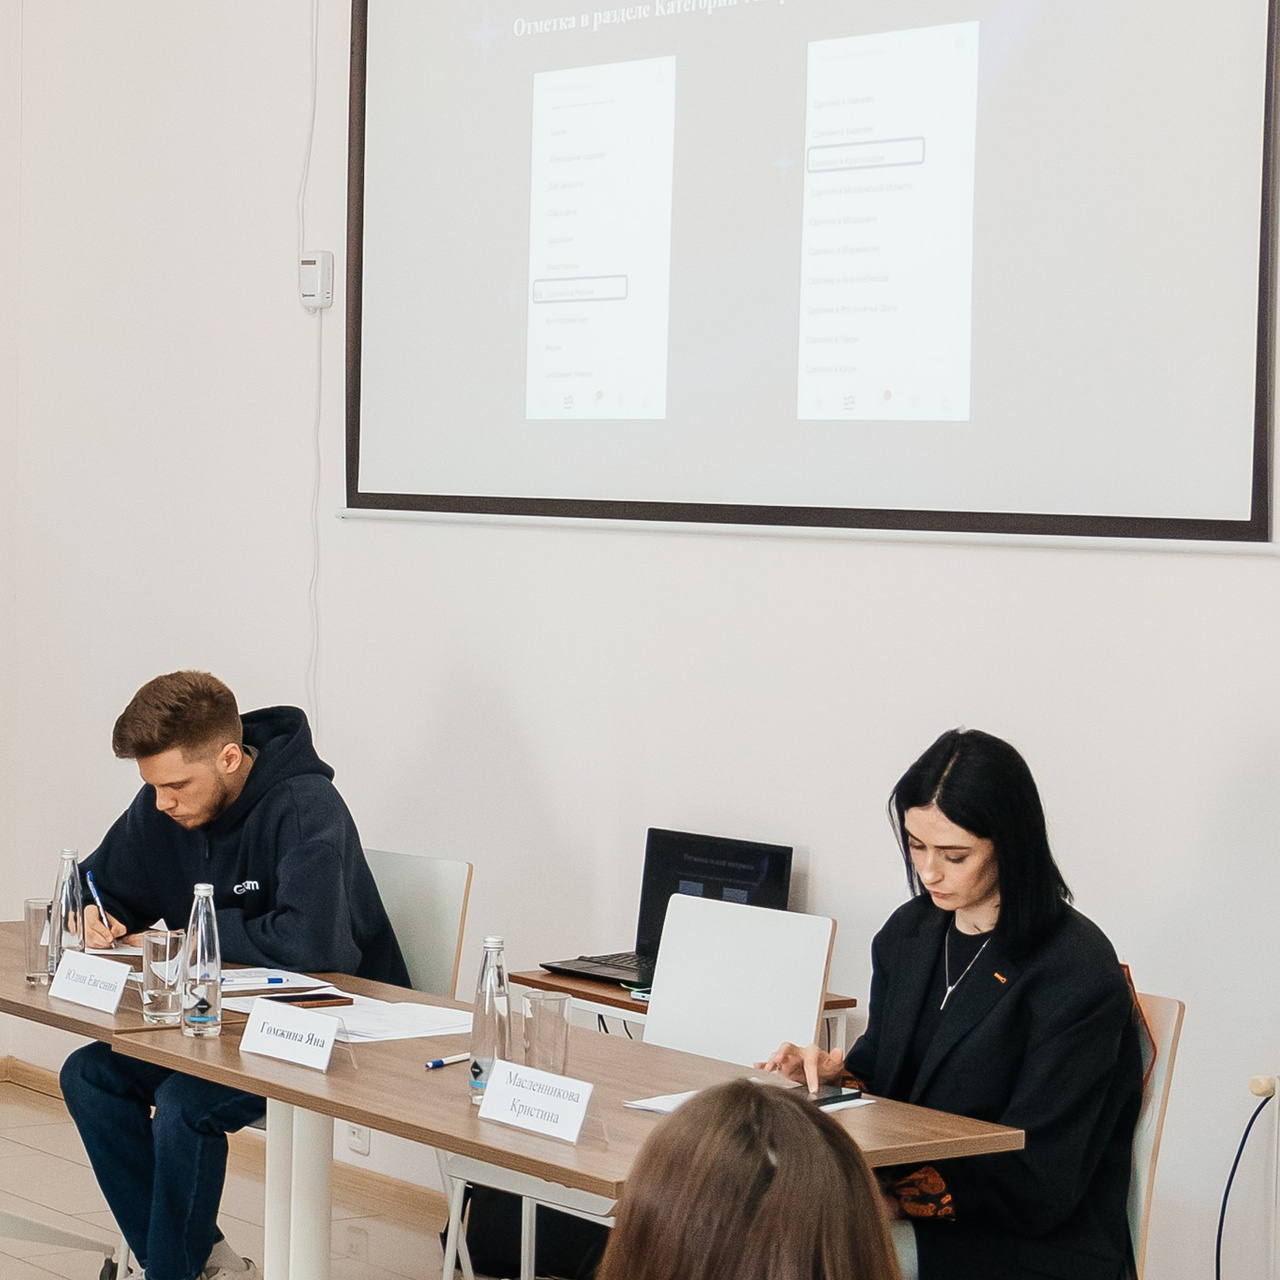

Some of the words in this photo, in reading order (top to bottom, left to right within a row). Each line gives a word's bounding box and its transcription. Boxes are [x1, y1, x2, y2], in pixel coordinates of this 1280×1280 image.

[513, 14, 576, 37] Отметка
[580, 11, 590, 27] в
[593, 1, 651, 31] разделе
[260, 1021, 304, 1042] Гомжина
[305, 1033, 326, 1048] Яна
[505, 1070, 581, 1103] Масленникова
[509, 1098, 560, 1124] Кристина
